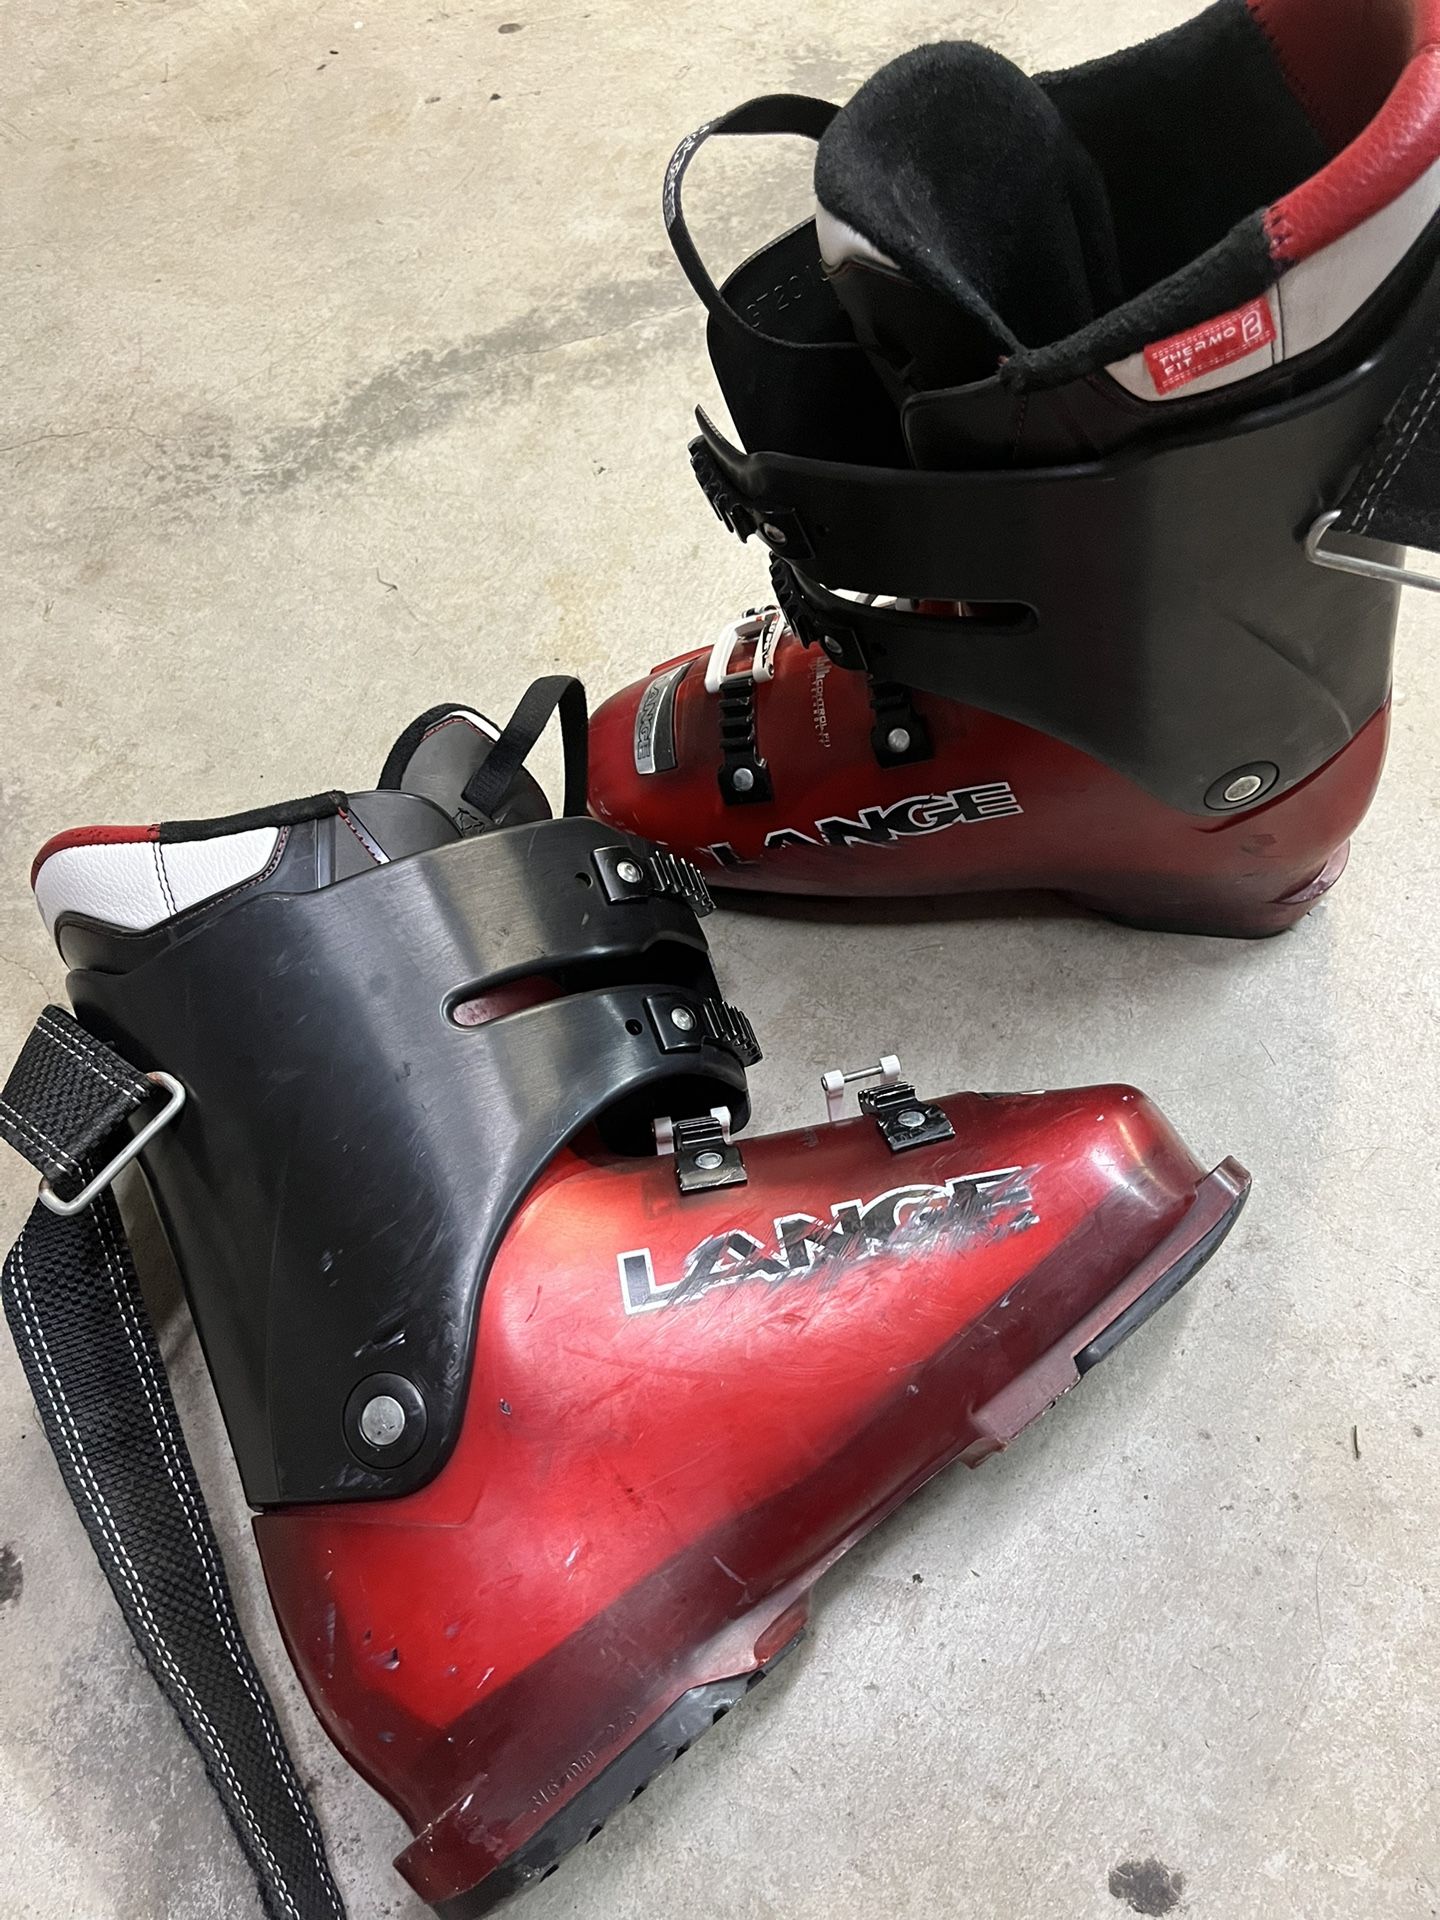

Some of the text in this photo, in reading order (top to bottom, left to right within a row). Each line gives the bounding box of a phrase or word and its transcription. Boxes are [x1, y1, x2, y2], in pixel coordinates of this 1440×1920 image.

[1158, 325, 1237, 367] THERMO
[1163, 356, 1194, 376] FIT
[699, 781, 1025, 867] LANGE
[616, 1165, 1042, 1315] LANGE
